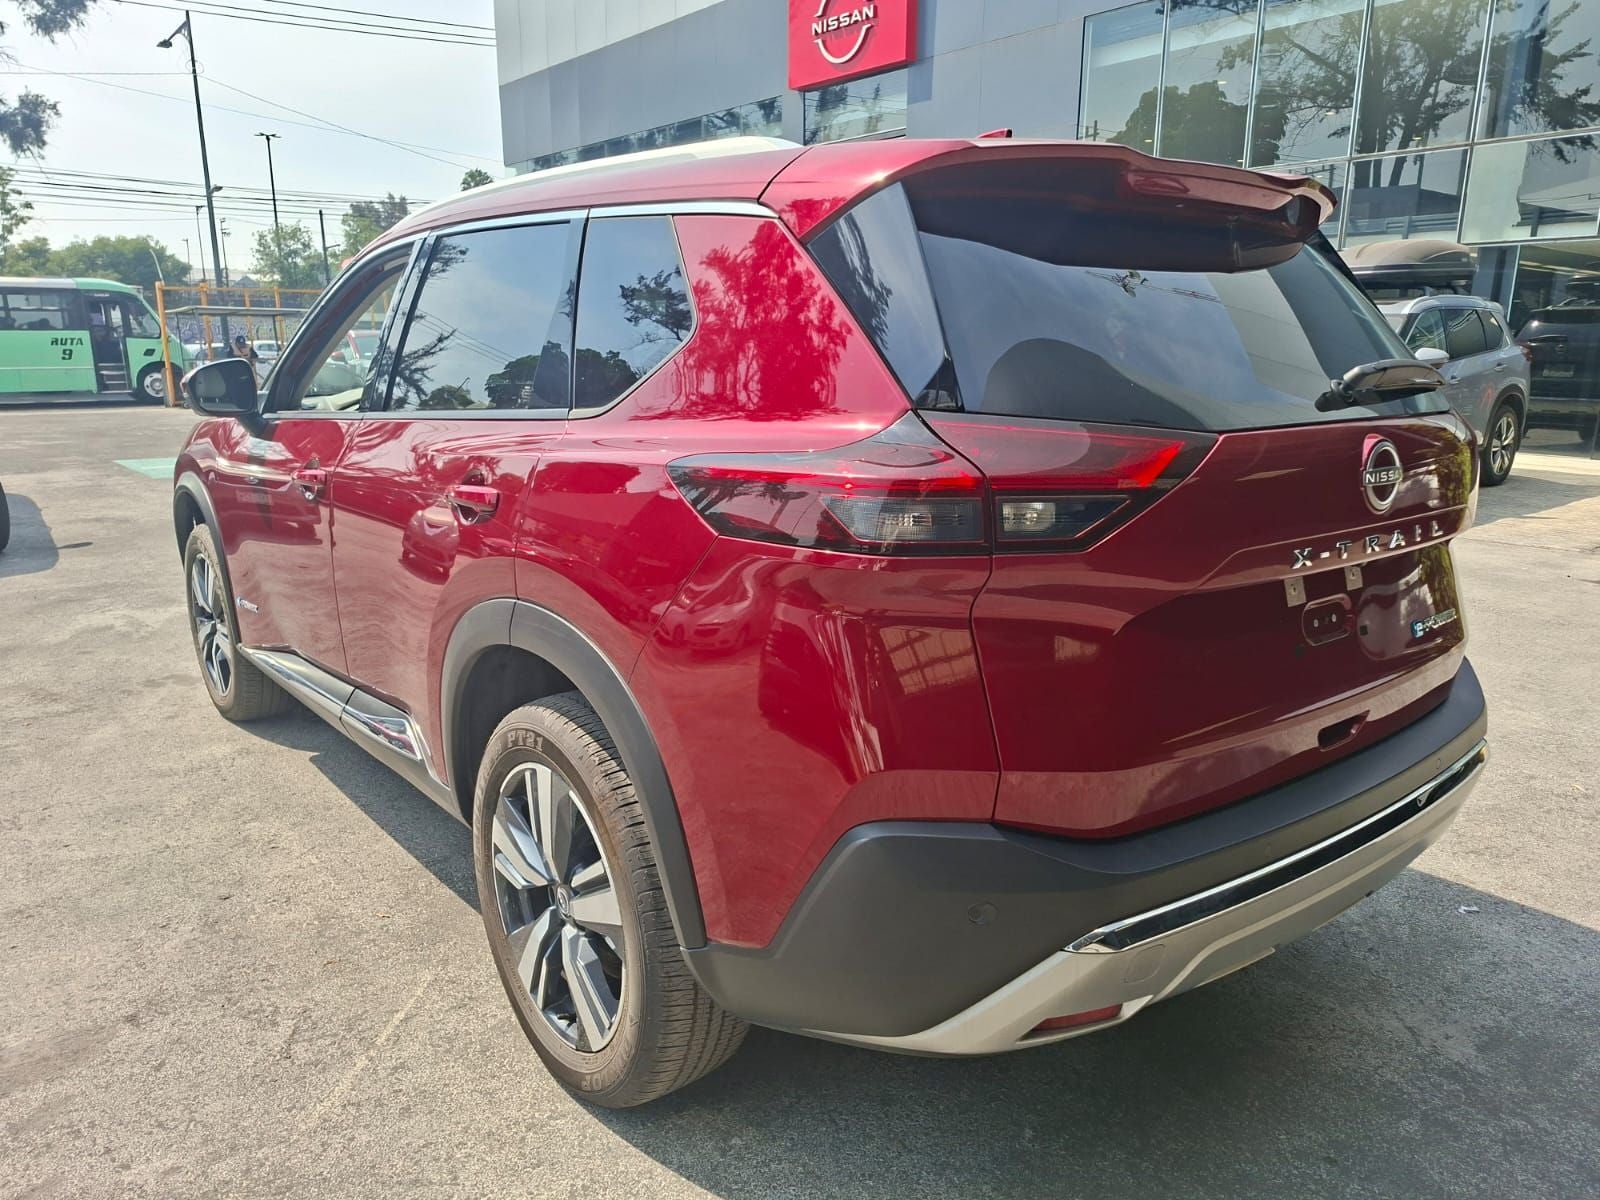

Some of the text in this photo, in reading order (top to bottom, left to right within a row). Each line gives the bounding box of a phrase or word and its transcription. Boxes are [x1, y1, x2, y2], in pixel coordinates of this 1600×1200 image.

[812, 4, 874, 36] NISSAN
[50, 337, 84, 347] RUTA
[61, 348, 73, 361] 9
[1365, 470, 1401, 483] NISSA
[1291, 520, 1444, 570] X-TRAIL
[507, 730, 543, 752] PT21
